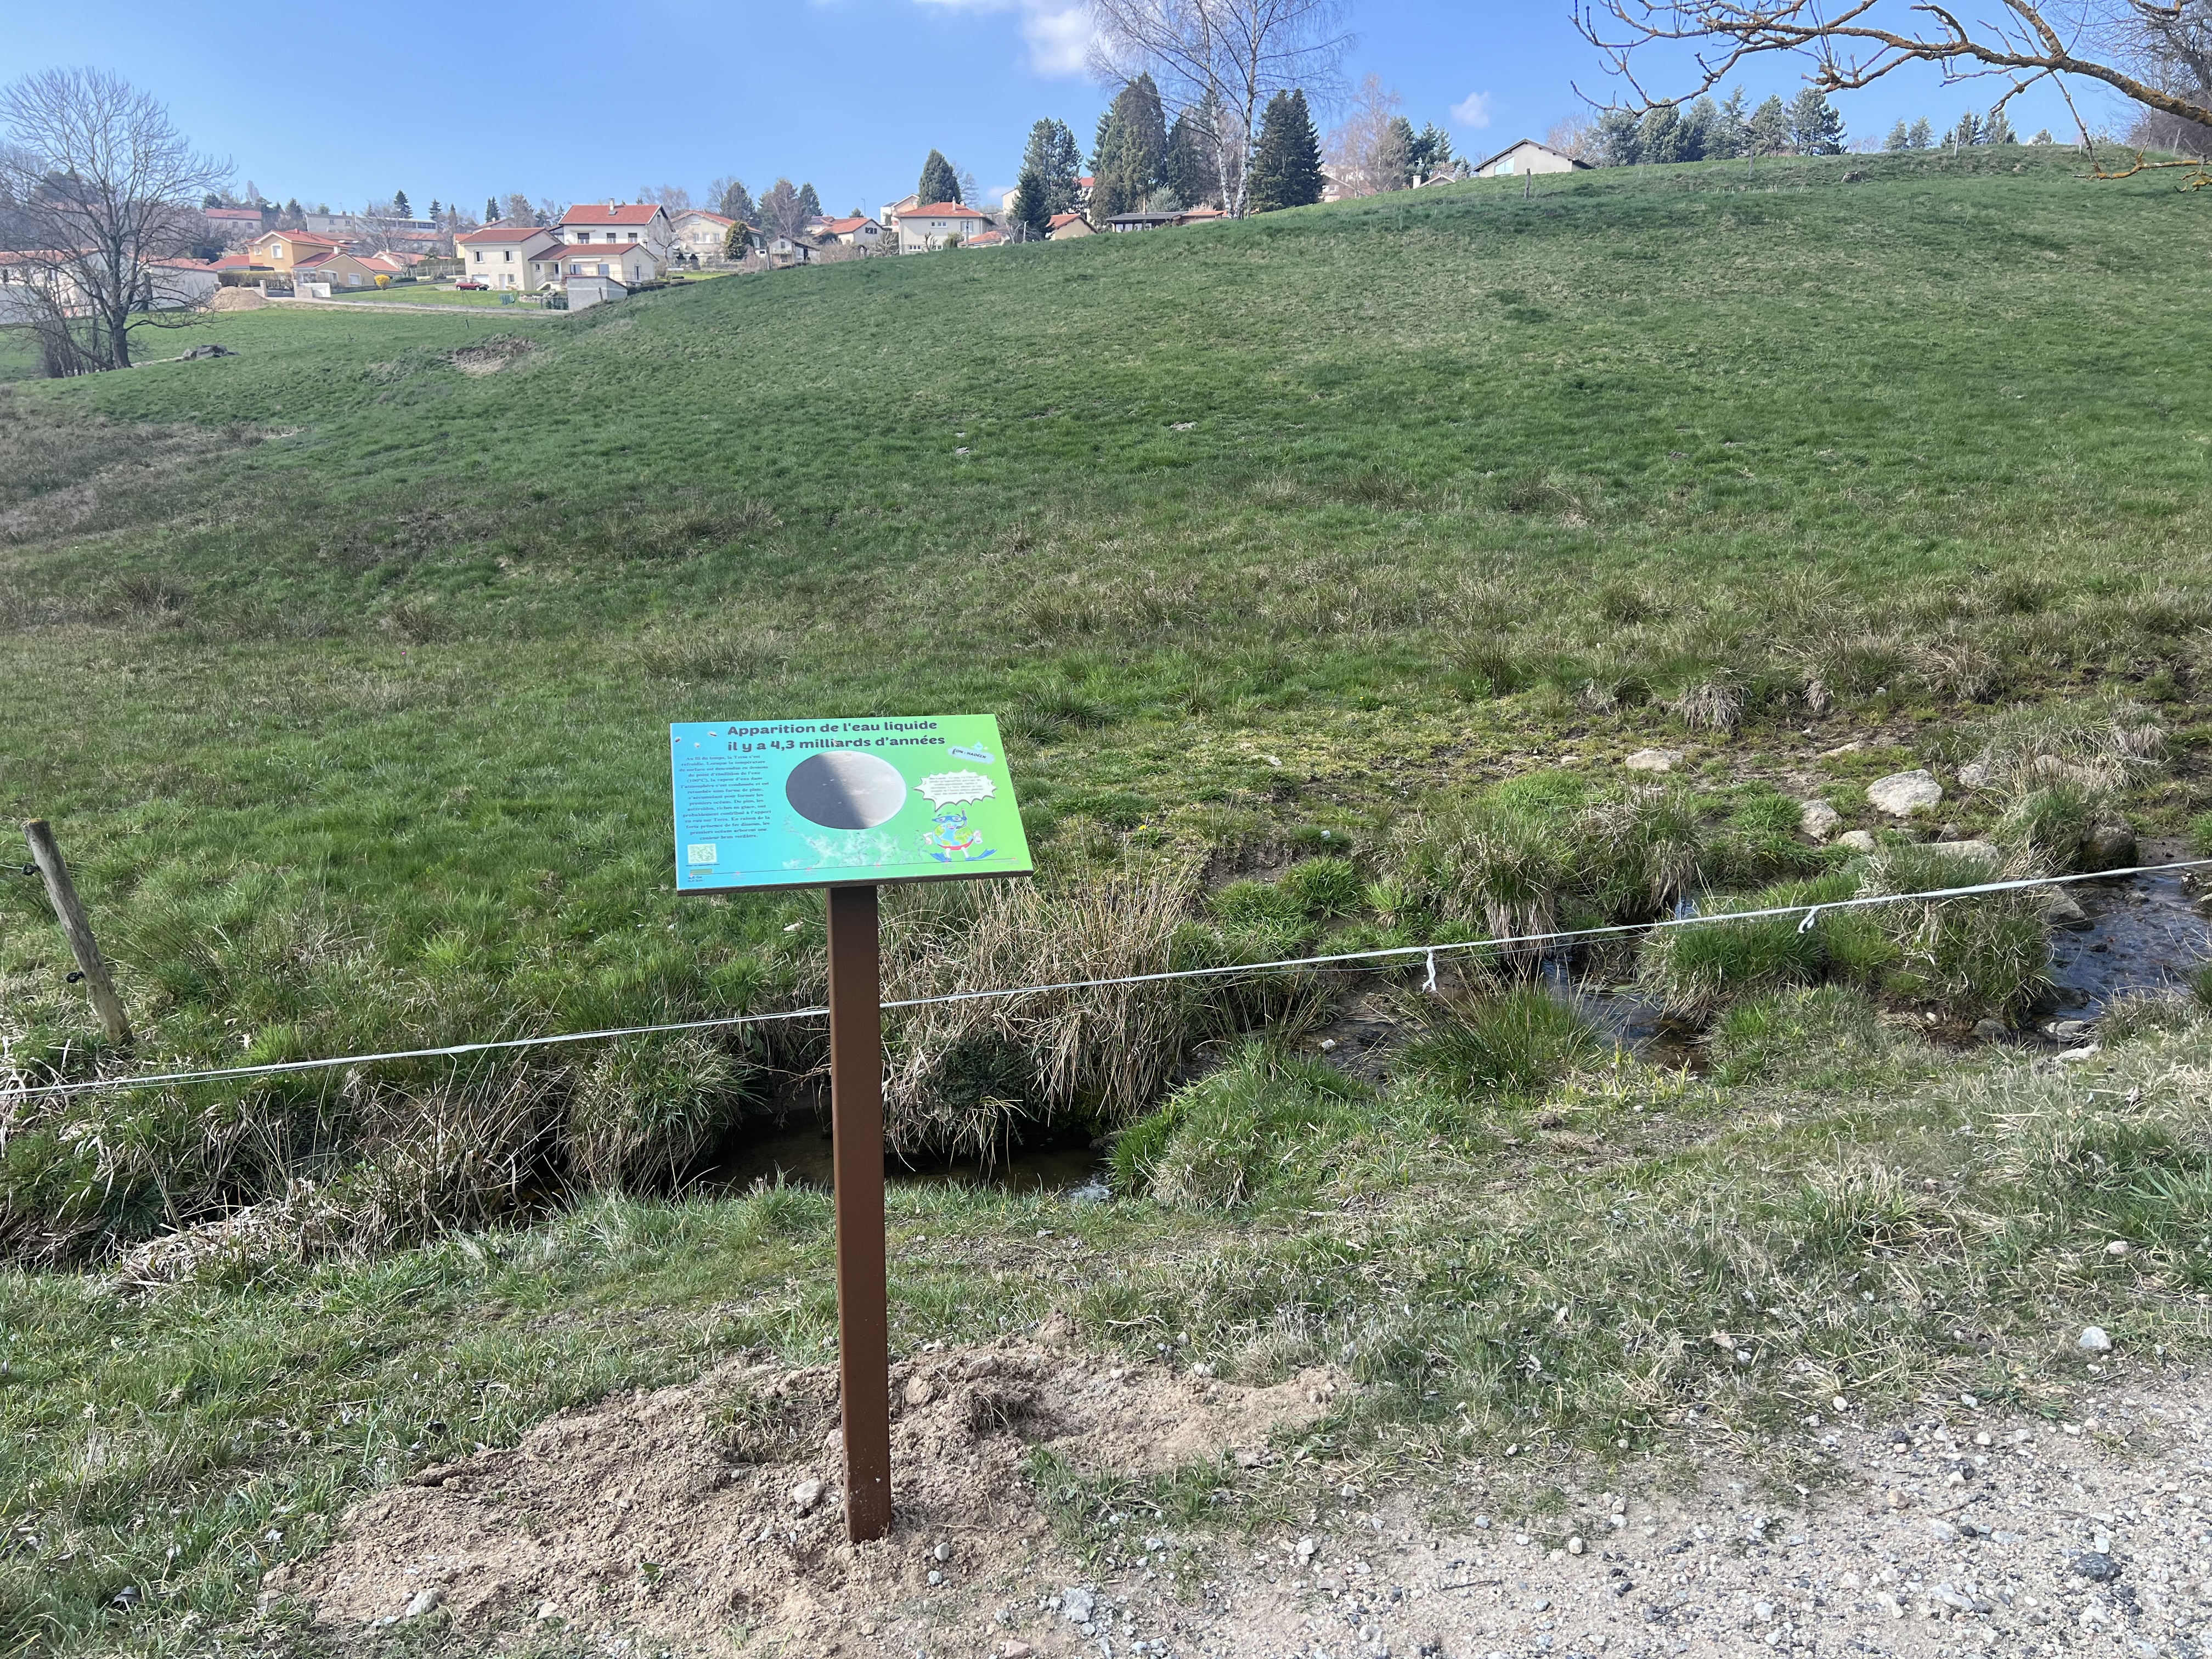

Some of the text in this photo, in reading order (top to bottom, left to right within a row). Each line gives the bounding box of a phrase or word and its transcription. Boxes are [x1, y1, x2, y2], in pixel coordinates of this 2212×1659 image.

[727, 721, 937, 736] Apparition de l'eau liquide
[728, 742, 737, 751] il
[742, 743, 752, 752] y
[771, 741, 794, 751] 4,3
[799, 738, 871, 748] milliards
